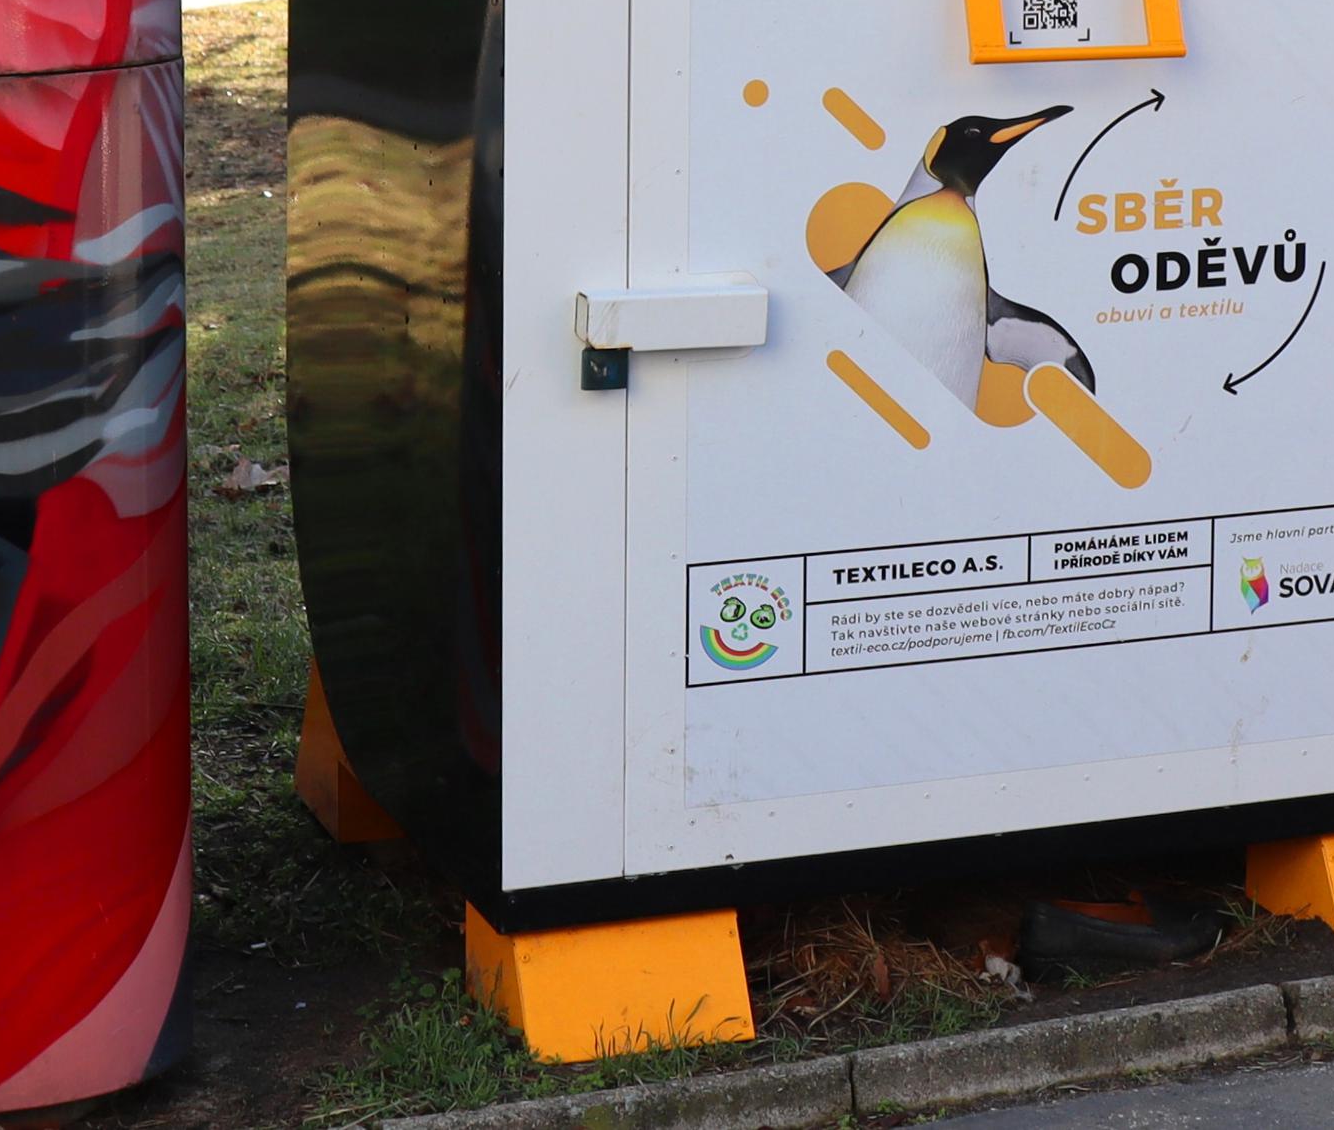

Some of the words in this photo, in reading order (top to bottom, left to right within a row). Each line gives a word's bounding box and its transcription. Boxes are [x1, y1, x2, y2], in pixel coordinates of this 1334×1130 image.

[1076, 178, 1223, 235] SBĚR
[1110, 229, 1307, 294] ODĚVŮ
[1096, 304, 1154, 324] obuvi
[1159, 307, 1172, 319] a
[1179, 298, 1245, 318] textilu
[1054, 534, 1140, 554] POMÁHÁME
[1144, 530, 1189, 545] LIDEM
[1230, 531, 1262, 544] Jsme
[1266, 526, 1305, 540] hlavní
[832, 558, 956, 585] TEXTILECO
[962, 555, 1004, 573] A.S.
[1061, 551, 1120, 570] PŘÍRODĚ
[1123, 547, 1156, 565] DÍKY
[1158, 545, 1189, 560] VÁM
[1279, 562, 1324, 575] Nadace
[710, 573, 769, 597] TEXTIL
[831, 613, 861, 626] Rádi
[865, 612, 881, 625] by
[884, 611, 904, 621] ste
[908, 609, 922, 619] se
[992, 599, 1022, 611] více,
[1026, 596, 1058, 607] nebo
[1062, 592, 1094, 604] máte
[1098, 587, 1135, 600] dobrý
[1139, 582, 1185, 598] nápad?
[831, 630, 855, 641] Tak
[925, 621, 956, 632] naše
[960, 615, 1011, 628] webové
[1015, 611, 1065, 624] stránky
[1069, 606, 1101, 617] nebo
[1105, 599, 1155, 614] sociální
[831, 631, 993, 657] textil-eco.cz/podporujeme
[1002, 619, 1116, 640] fb.com/TextilEcoCz
